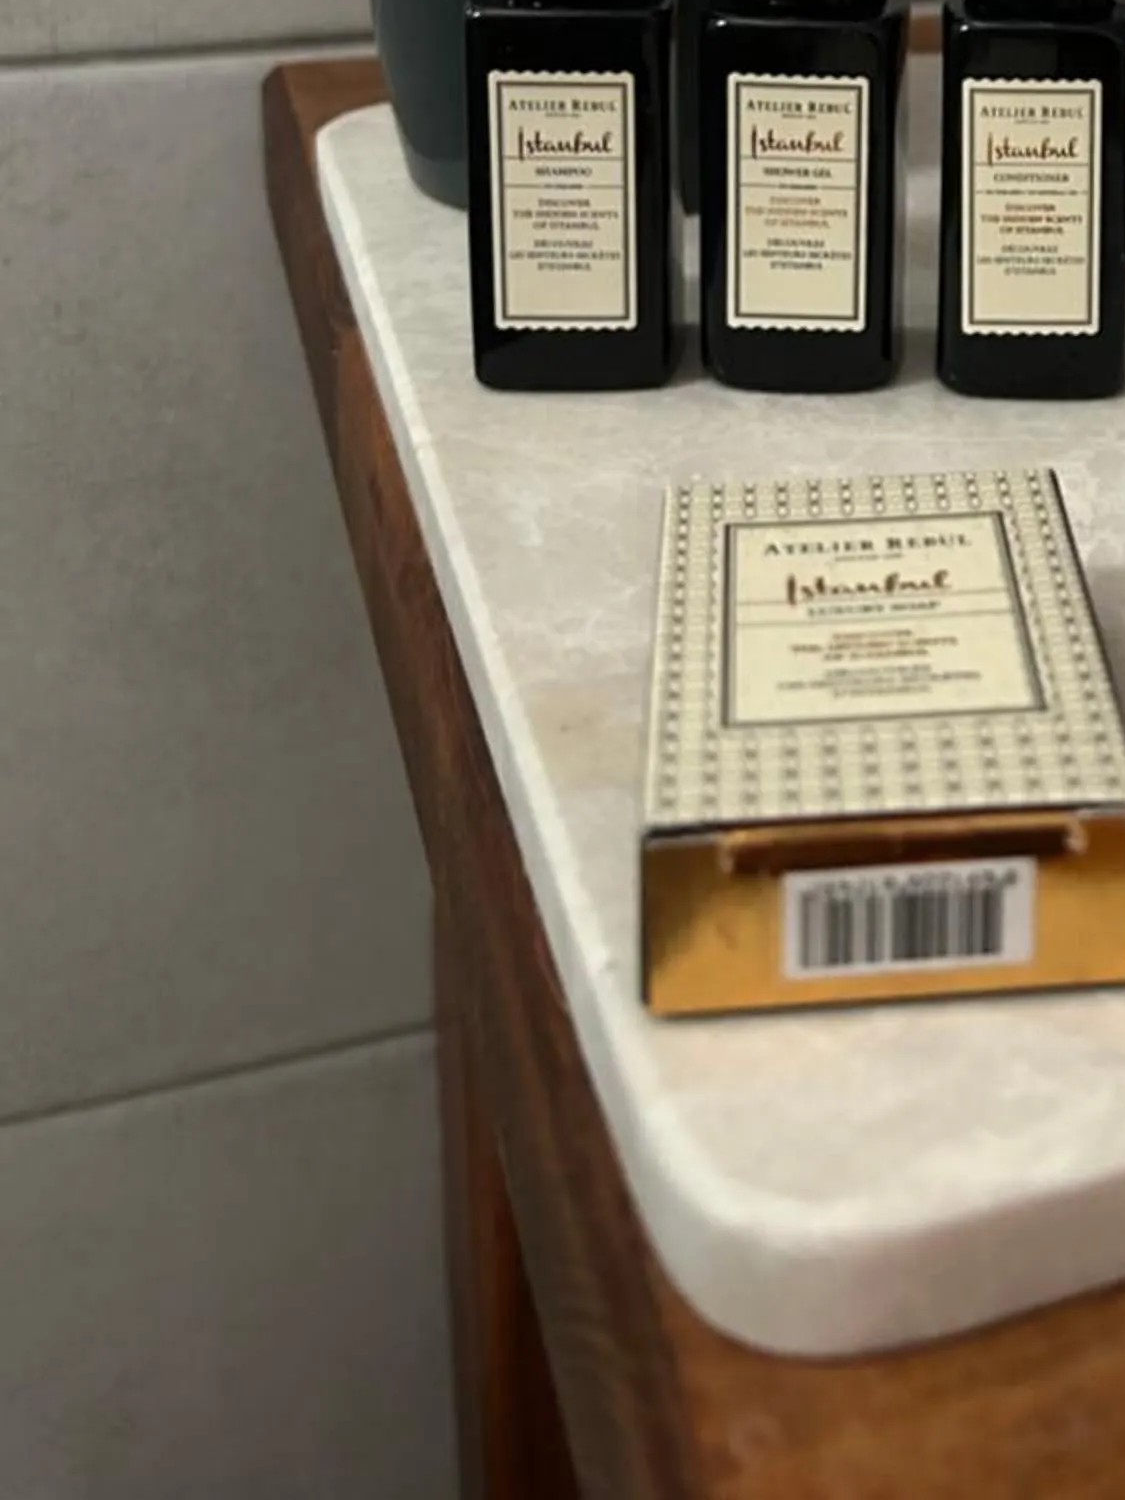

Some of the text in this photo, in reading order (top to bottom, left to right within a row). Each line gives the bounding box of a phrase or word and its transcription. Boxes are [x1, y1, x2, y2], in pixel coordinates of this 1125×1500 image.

[508, 99, 566, 113] ATELIER
[747, 99, 802, 113] ATELIER
[980, 105, 1037, 118] ATELIER
